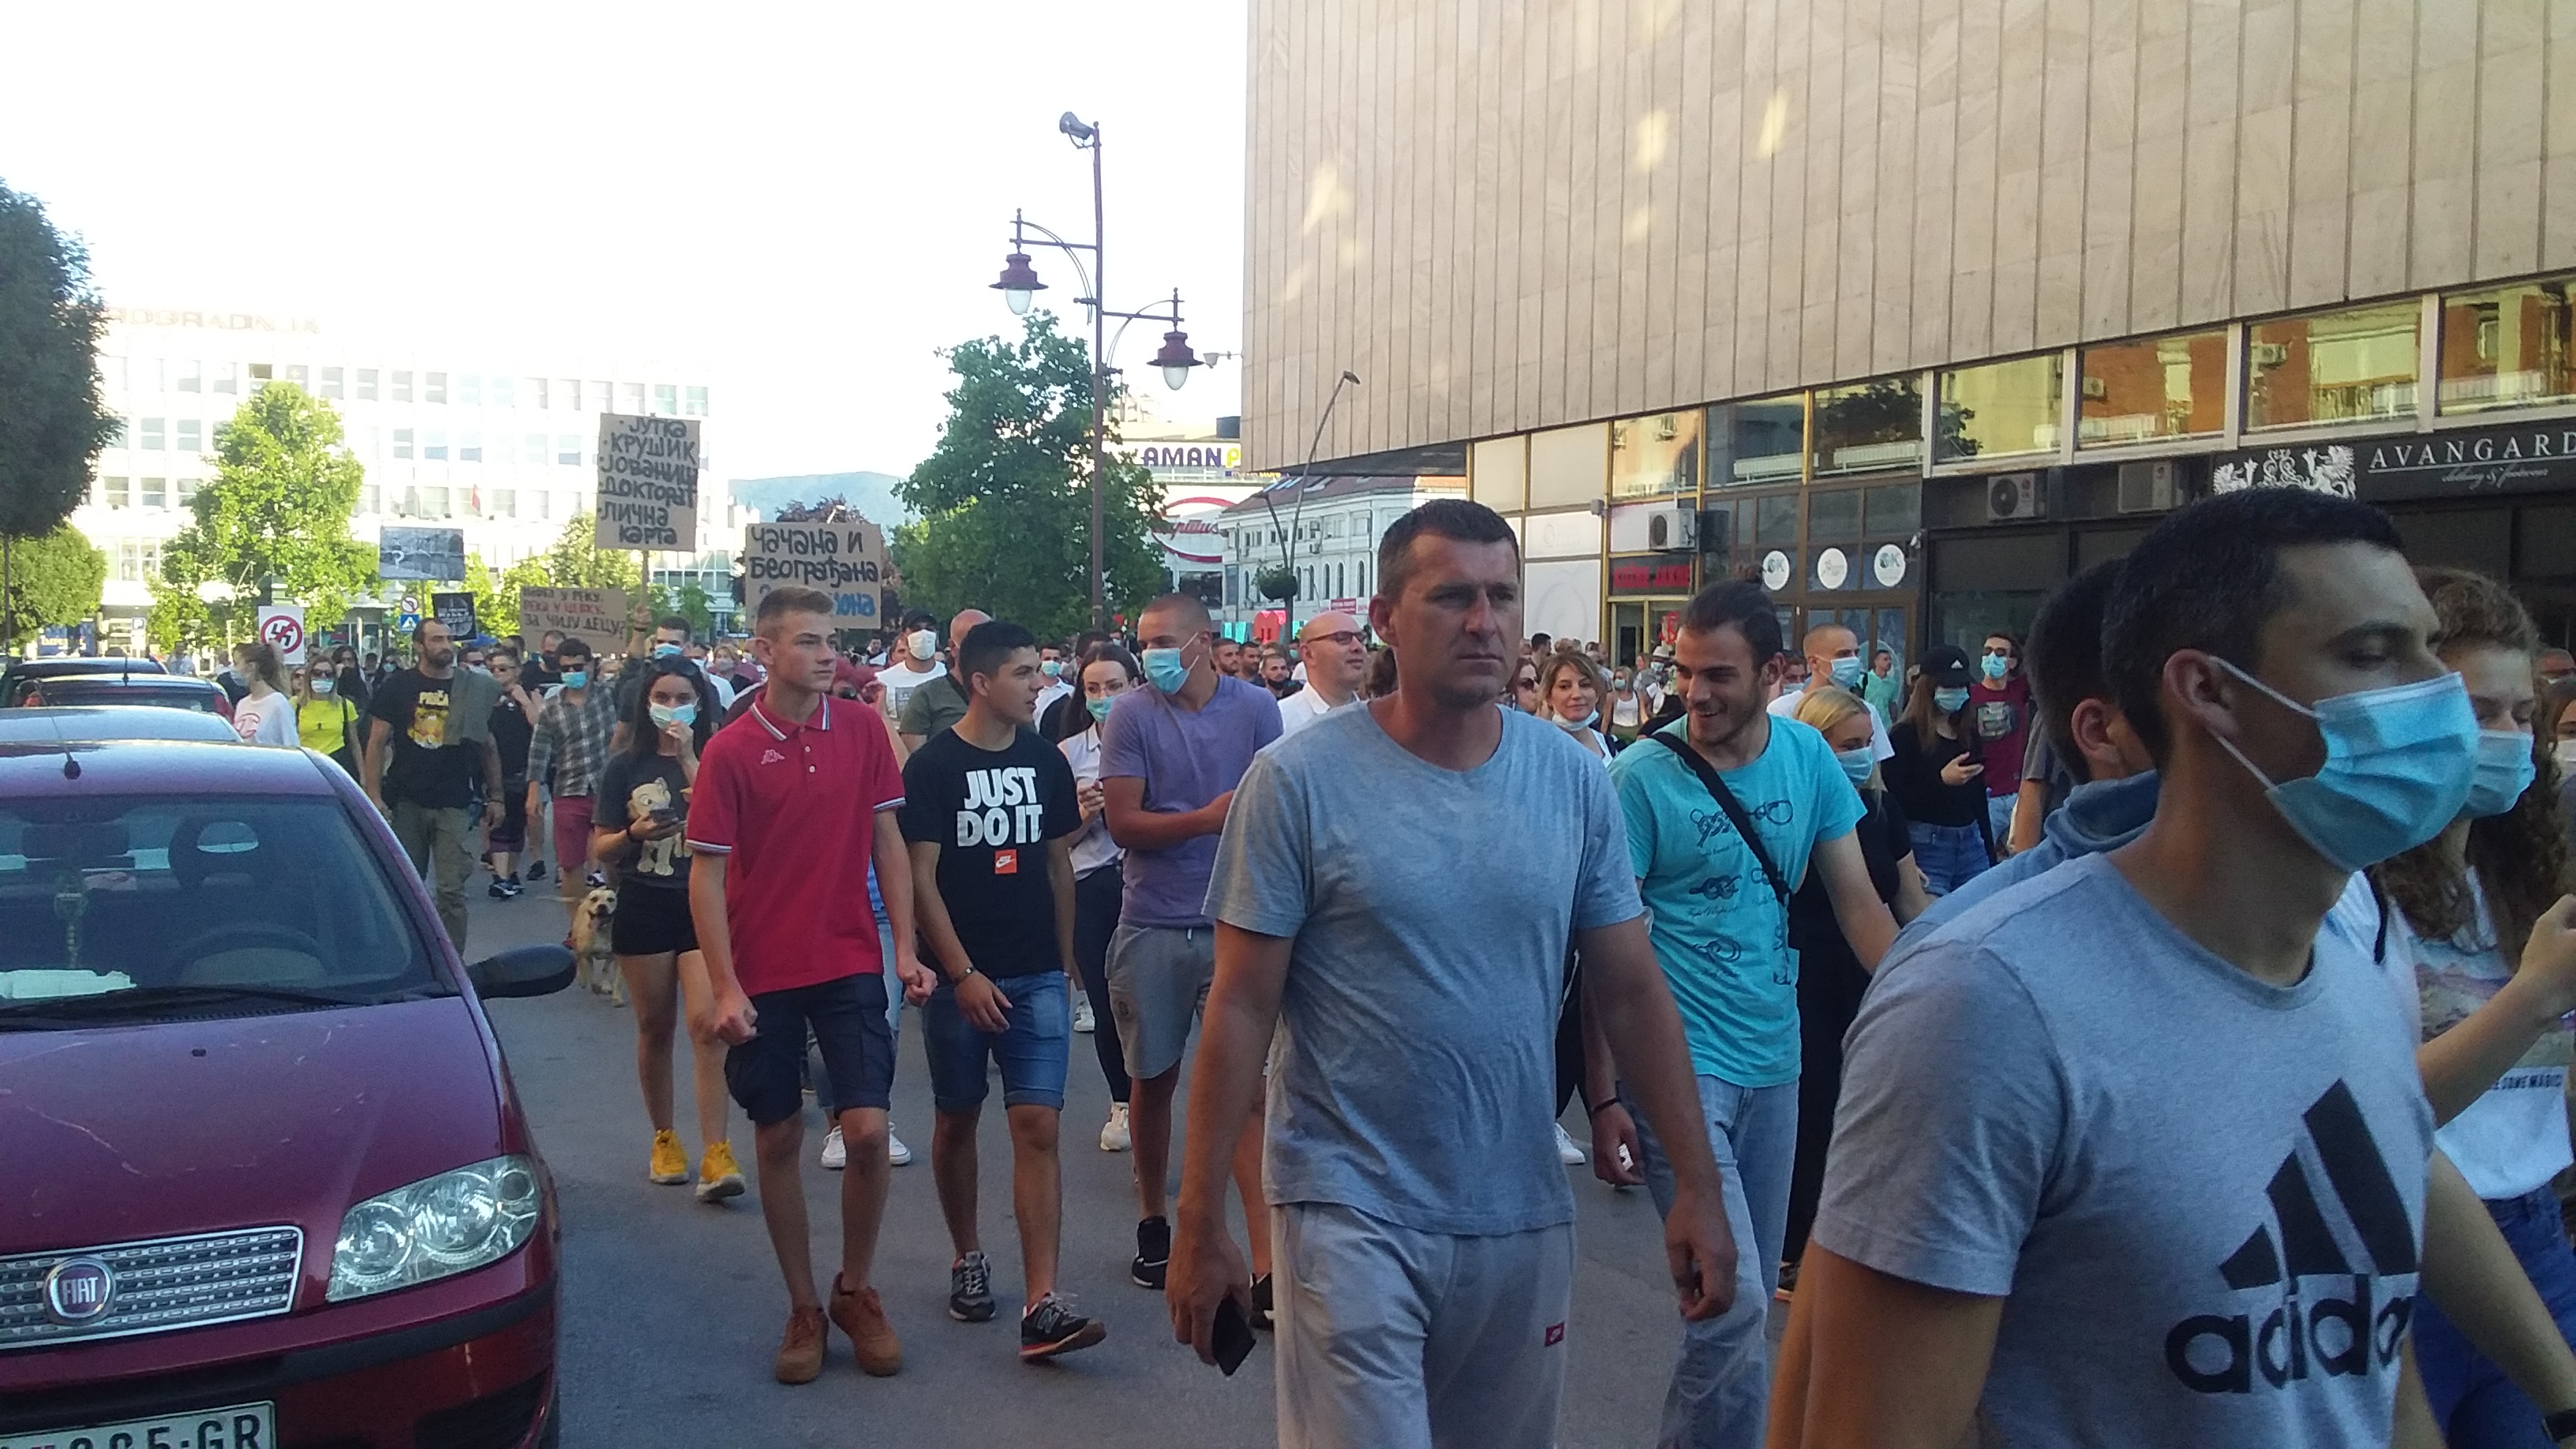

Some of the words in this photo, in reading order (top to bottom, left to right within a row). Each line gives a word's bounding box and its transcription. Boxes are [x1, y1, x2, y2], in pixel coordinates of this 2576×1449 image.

[611, 432, 696, 465] КРУШИК
[1144, 447, 1222, 467] AMAN
[964, 766, 1037, 810] JUST
[957, 807, 1010, 848] DO
[1015, 803, 1043, 844] IT
[62, 1276, 99, 1306] FIAT
